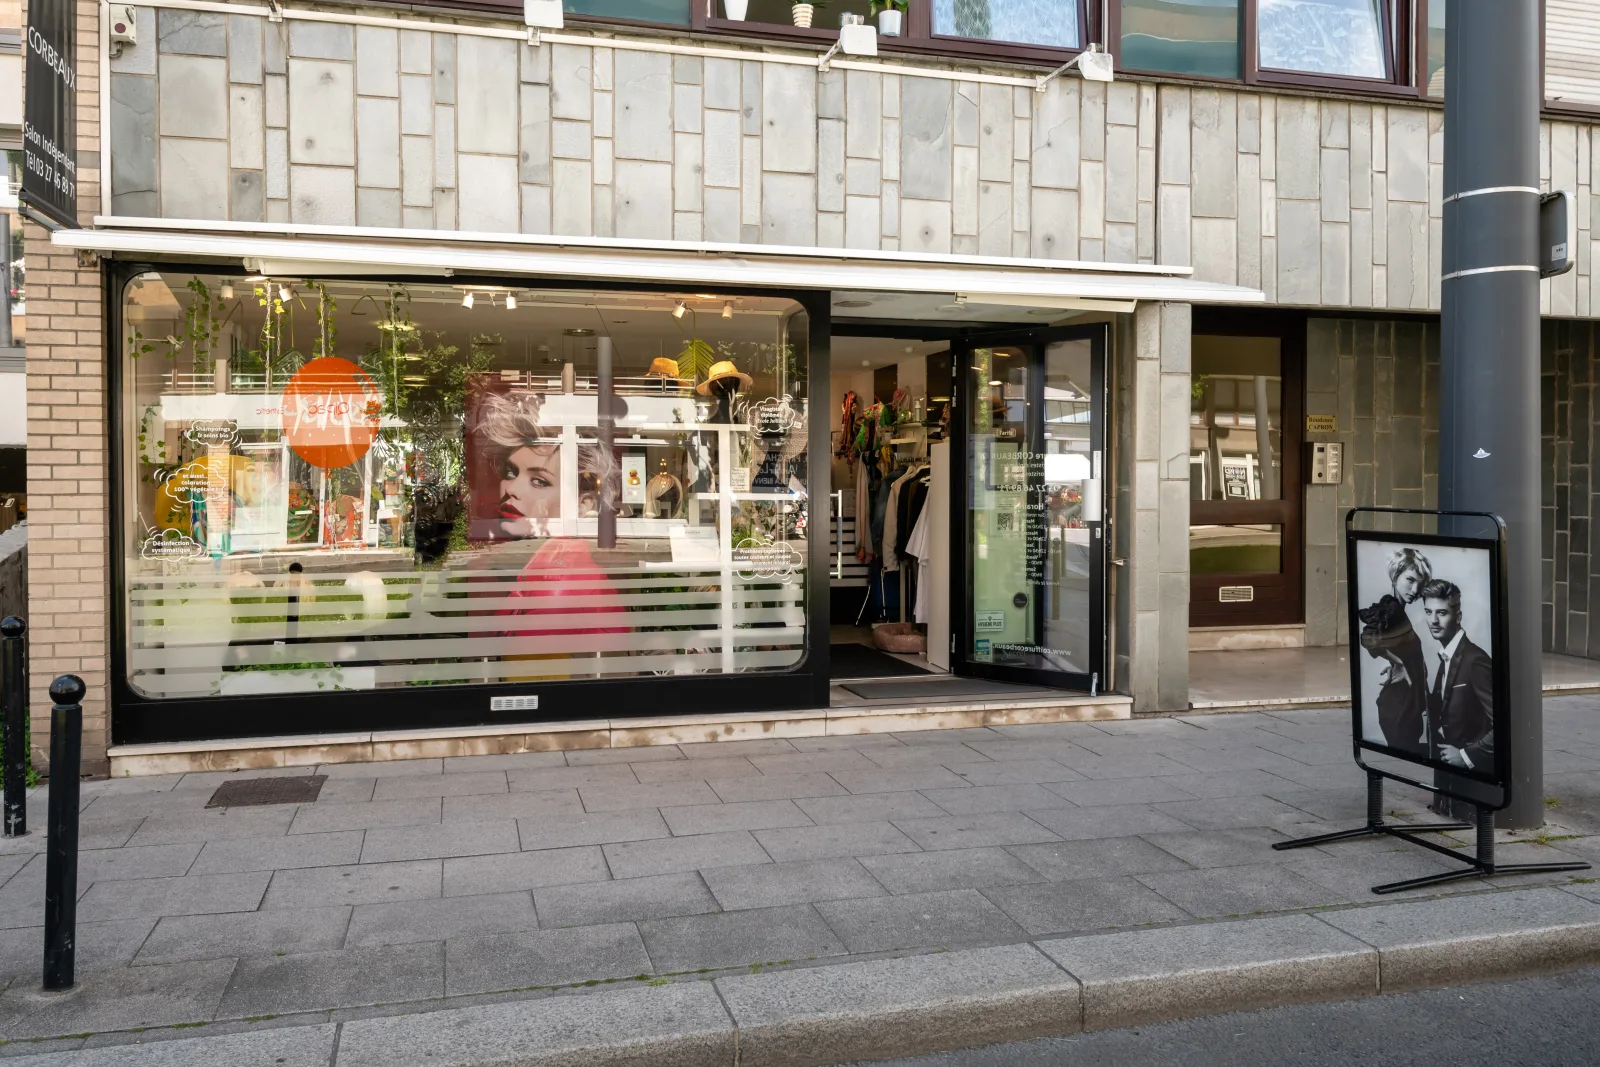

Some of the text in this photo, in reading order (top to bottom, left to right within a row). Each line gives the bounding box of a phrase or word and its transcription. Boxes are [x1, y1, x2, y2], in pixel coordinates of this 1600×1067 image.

[28, 26, 76, 92] CORBEAUX
[25, 121, 40, 147] Salon
[45, 163, 52, 183] 27
